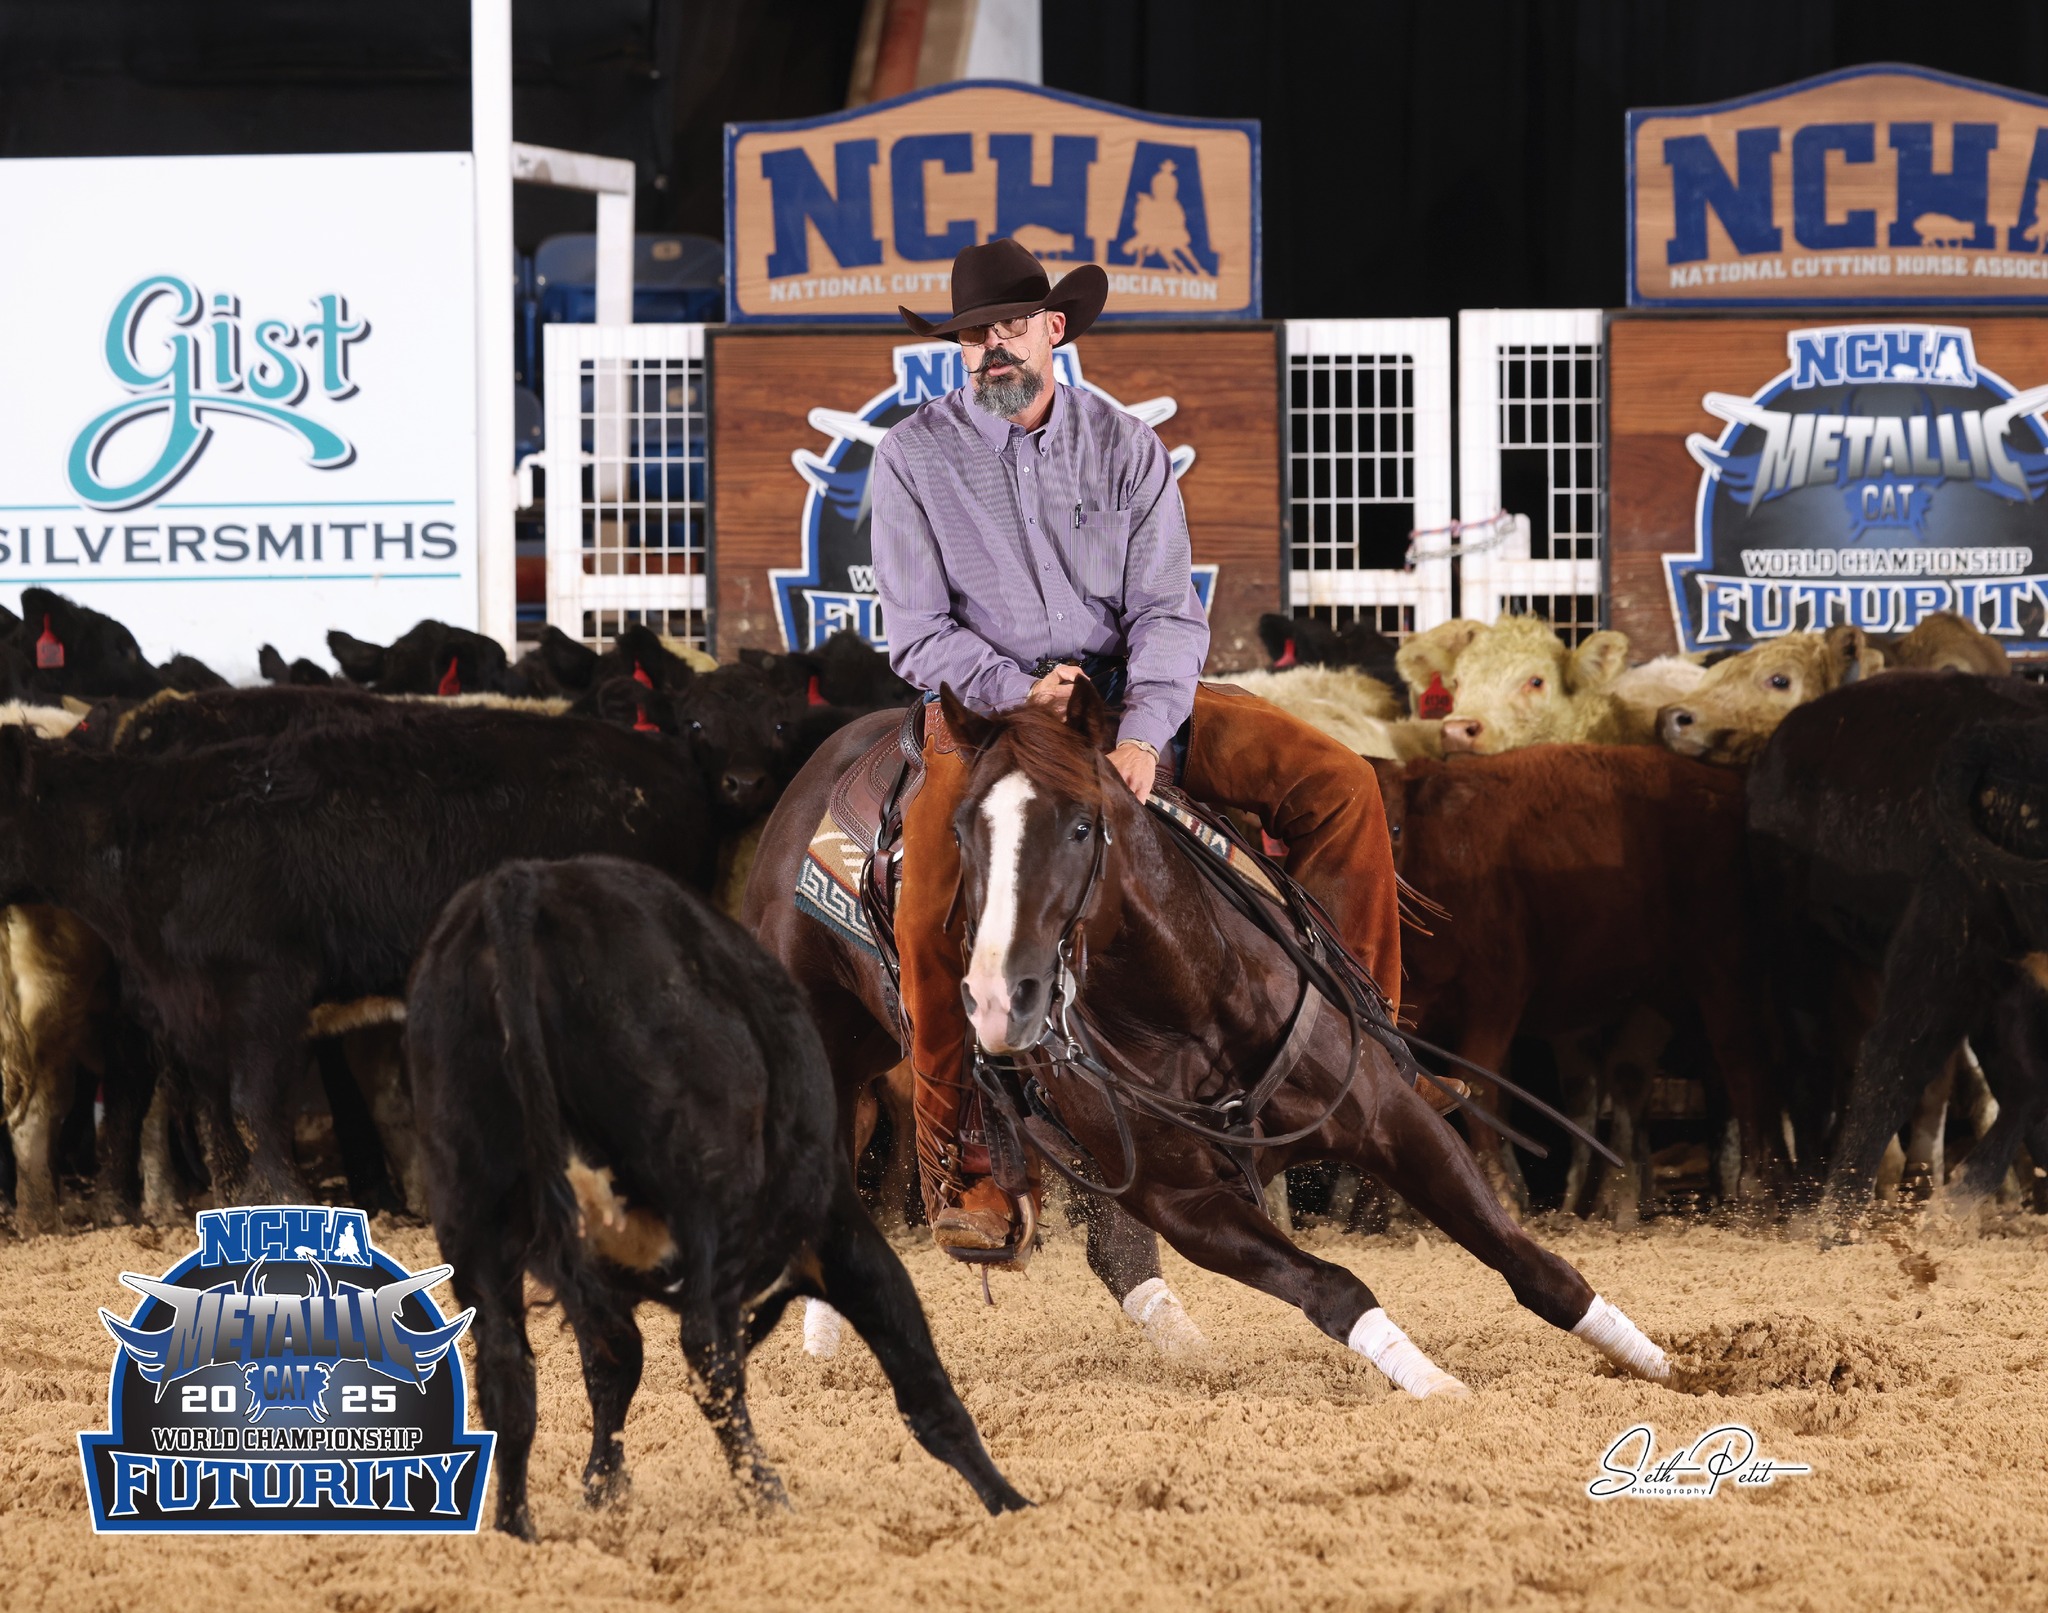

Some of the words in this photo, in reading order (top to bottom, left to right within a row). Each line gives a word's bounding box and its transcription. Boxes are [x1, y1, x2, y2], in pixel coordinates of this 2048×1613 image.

[761, 132, 1221, 280] NCHA
[769, 272, 887, 301] NATIONAL
[891, 271, 952, 294] CUTT
[1107, 272, 1218, 300] SOCIATION
[1669, 257, 1787, 288] NATIONAL
[1792, 255, 1892, 277] CUTTING
[1896, 255, 1968, 276] HORSE
[1793, 331, 1977, 387] NCHA
[67, 274, 371, 512] Gist
[1722, 402, 2040, 518] METALLIC
[1861, 484, 1914, 522] CAT
[1742, 549, 1837, 577] WORLD
[1839, 546, 2033, 576] CHAMPIONSHIP
